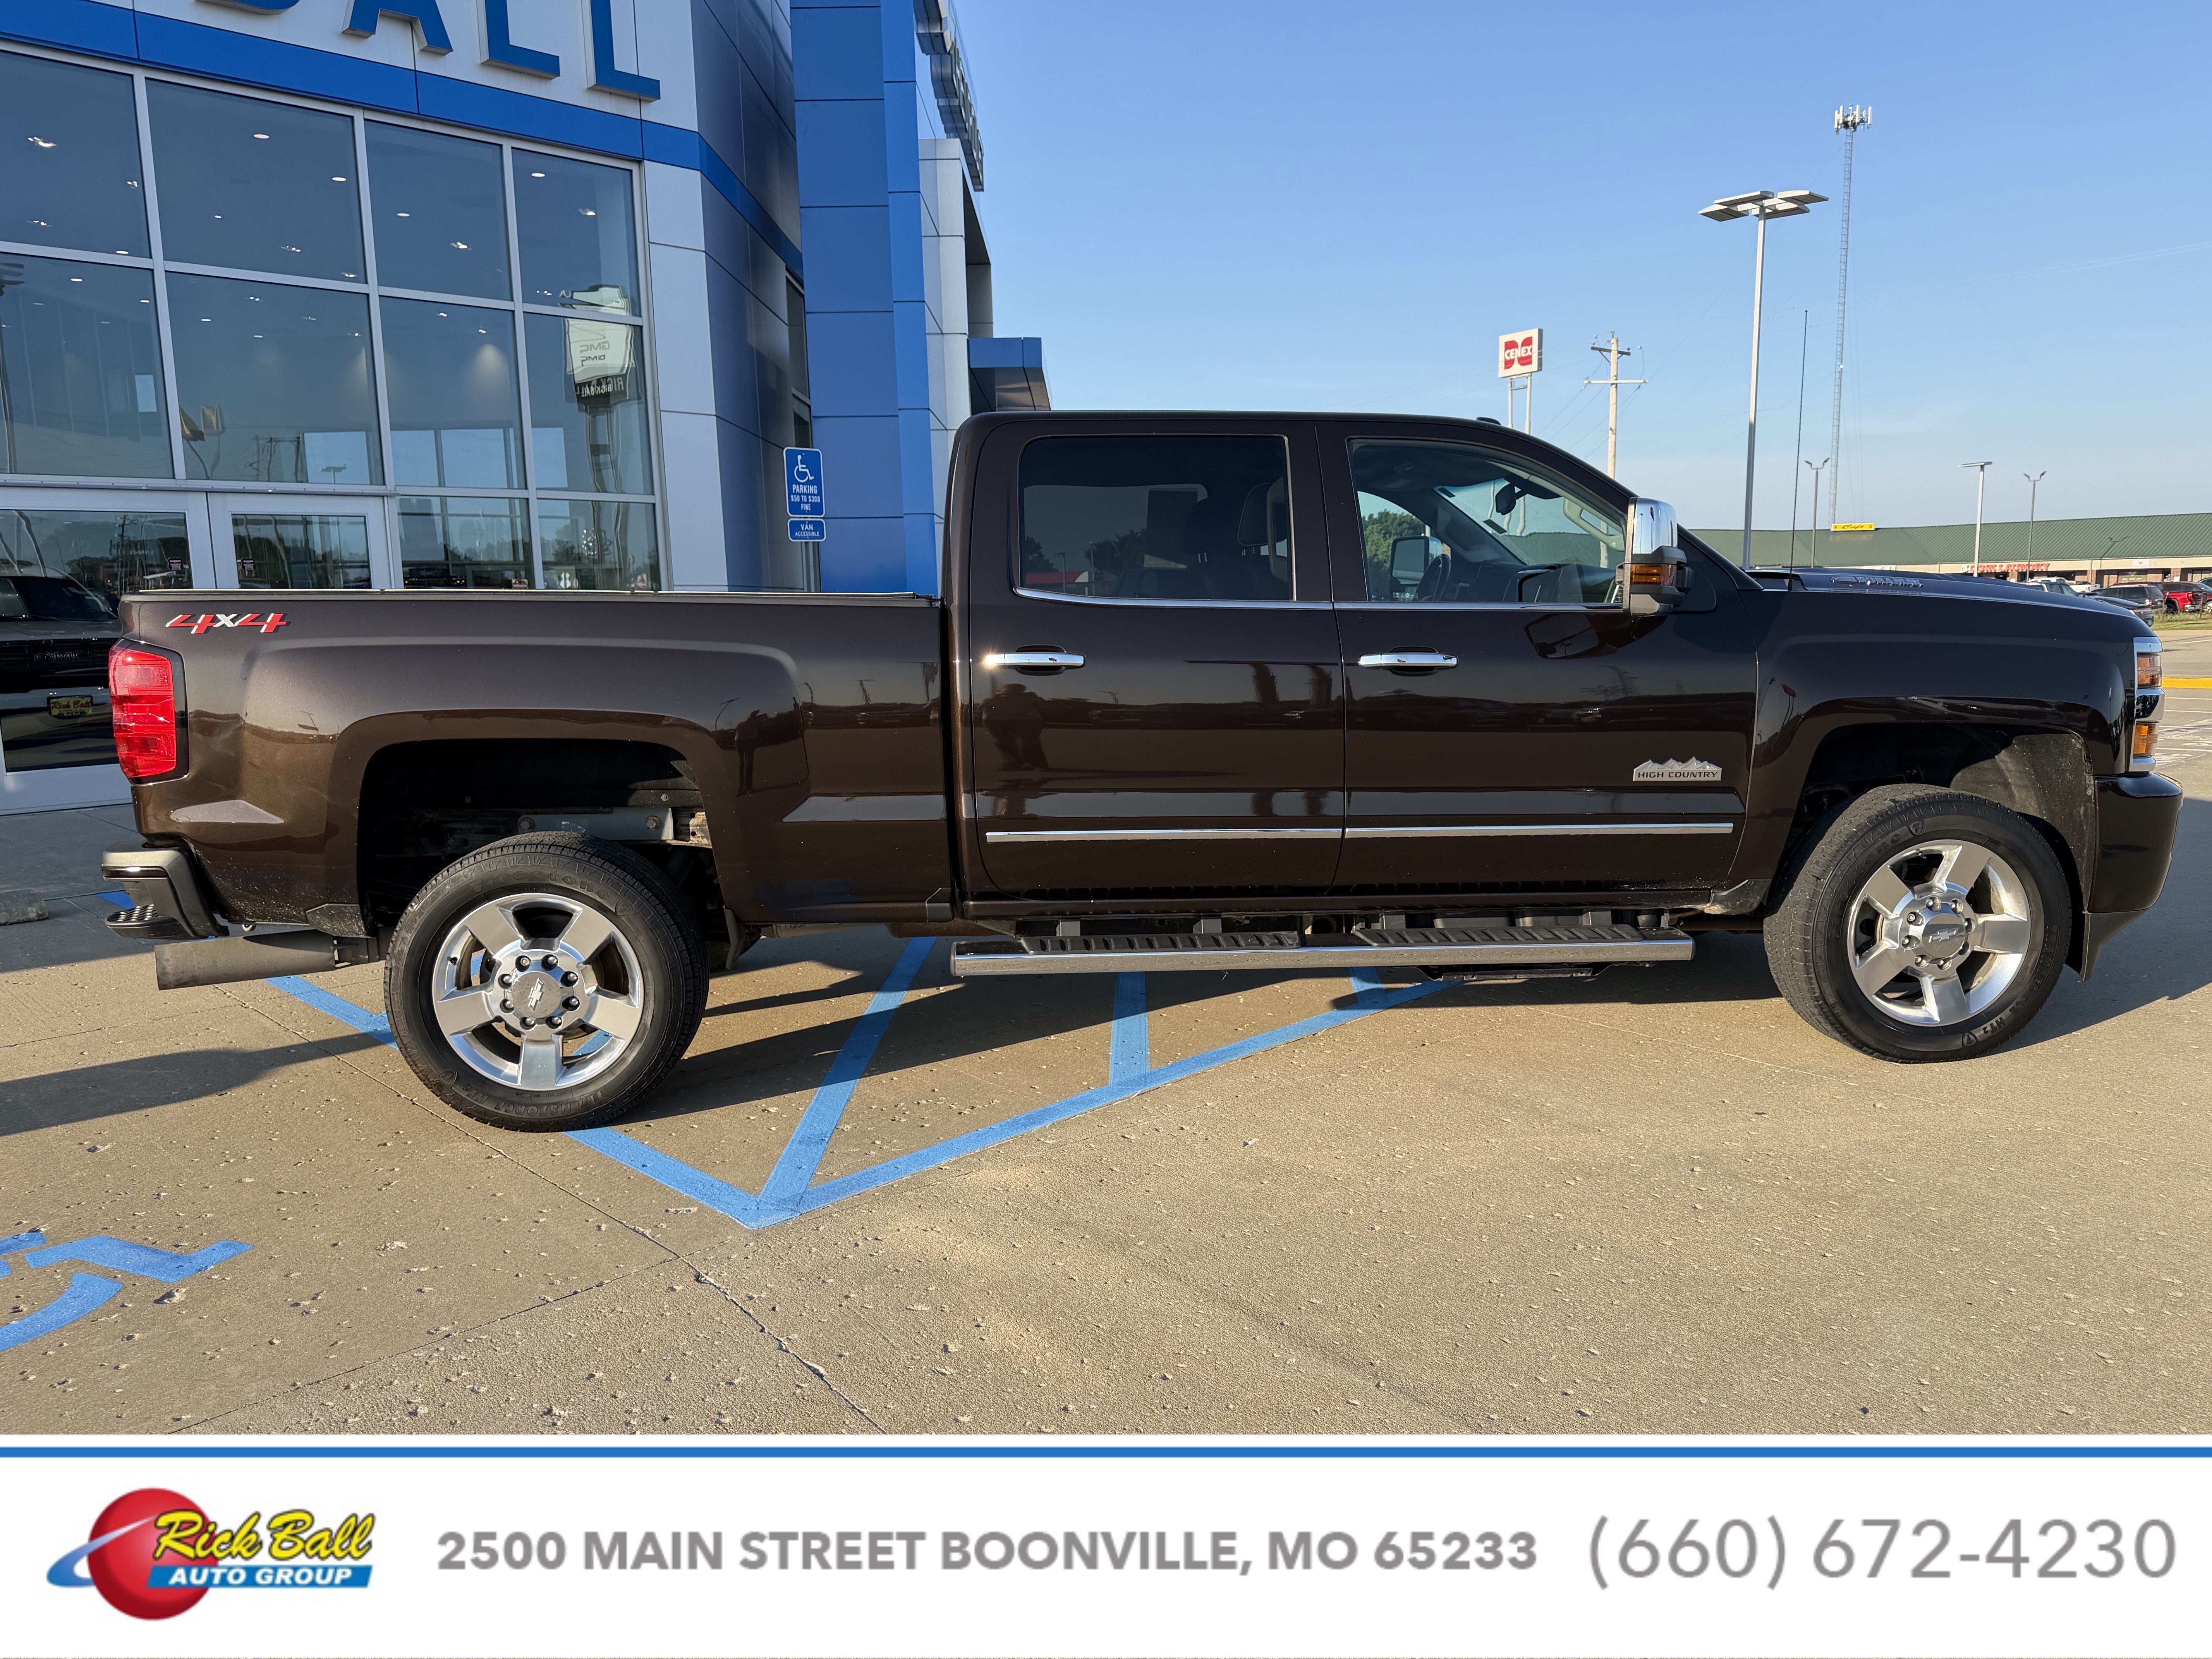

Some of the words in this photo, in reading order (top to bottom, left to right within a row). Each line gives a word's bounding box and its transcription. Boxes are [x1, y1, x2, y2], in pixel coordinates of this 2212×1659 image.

[196, 0, 661, 102] LL
[1504, 345, 1532, 360] CENEX
[792, 484, 817, 494] PARKING
[1970, 564, 1996, 573] COIN
[1999, 563, 2051, 572] LAUNDRY
[494, 1091, 605, 1117] TRANSFORCE
